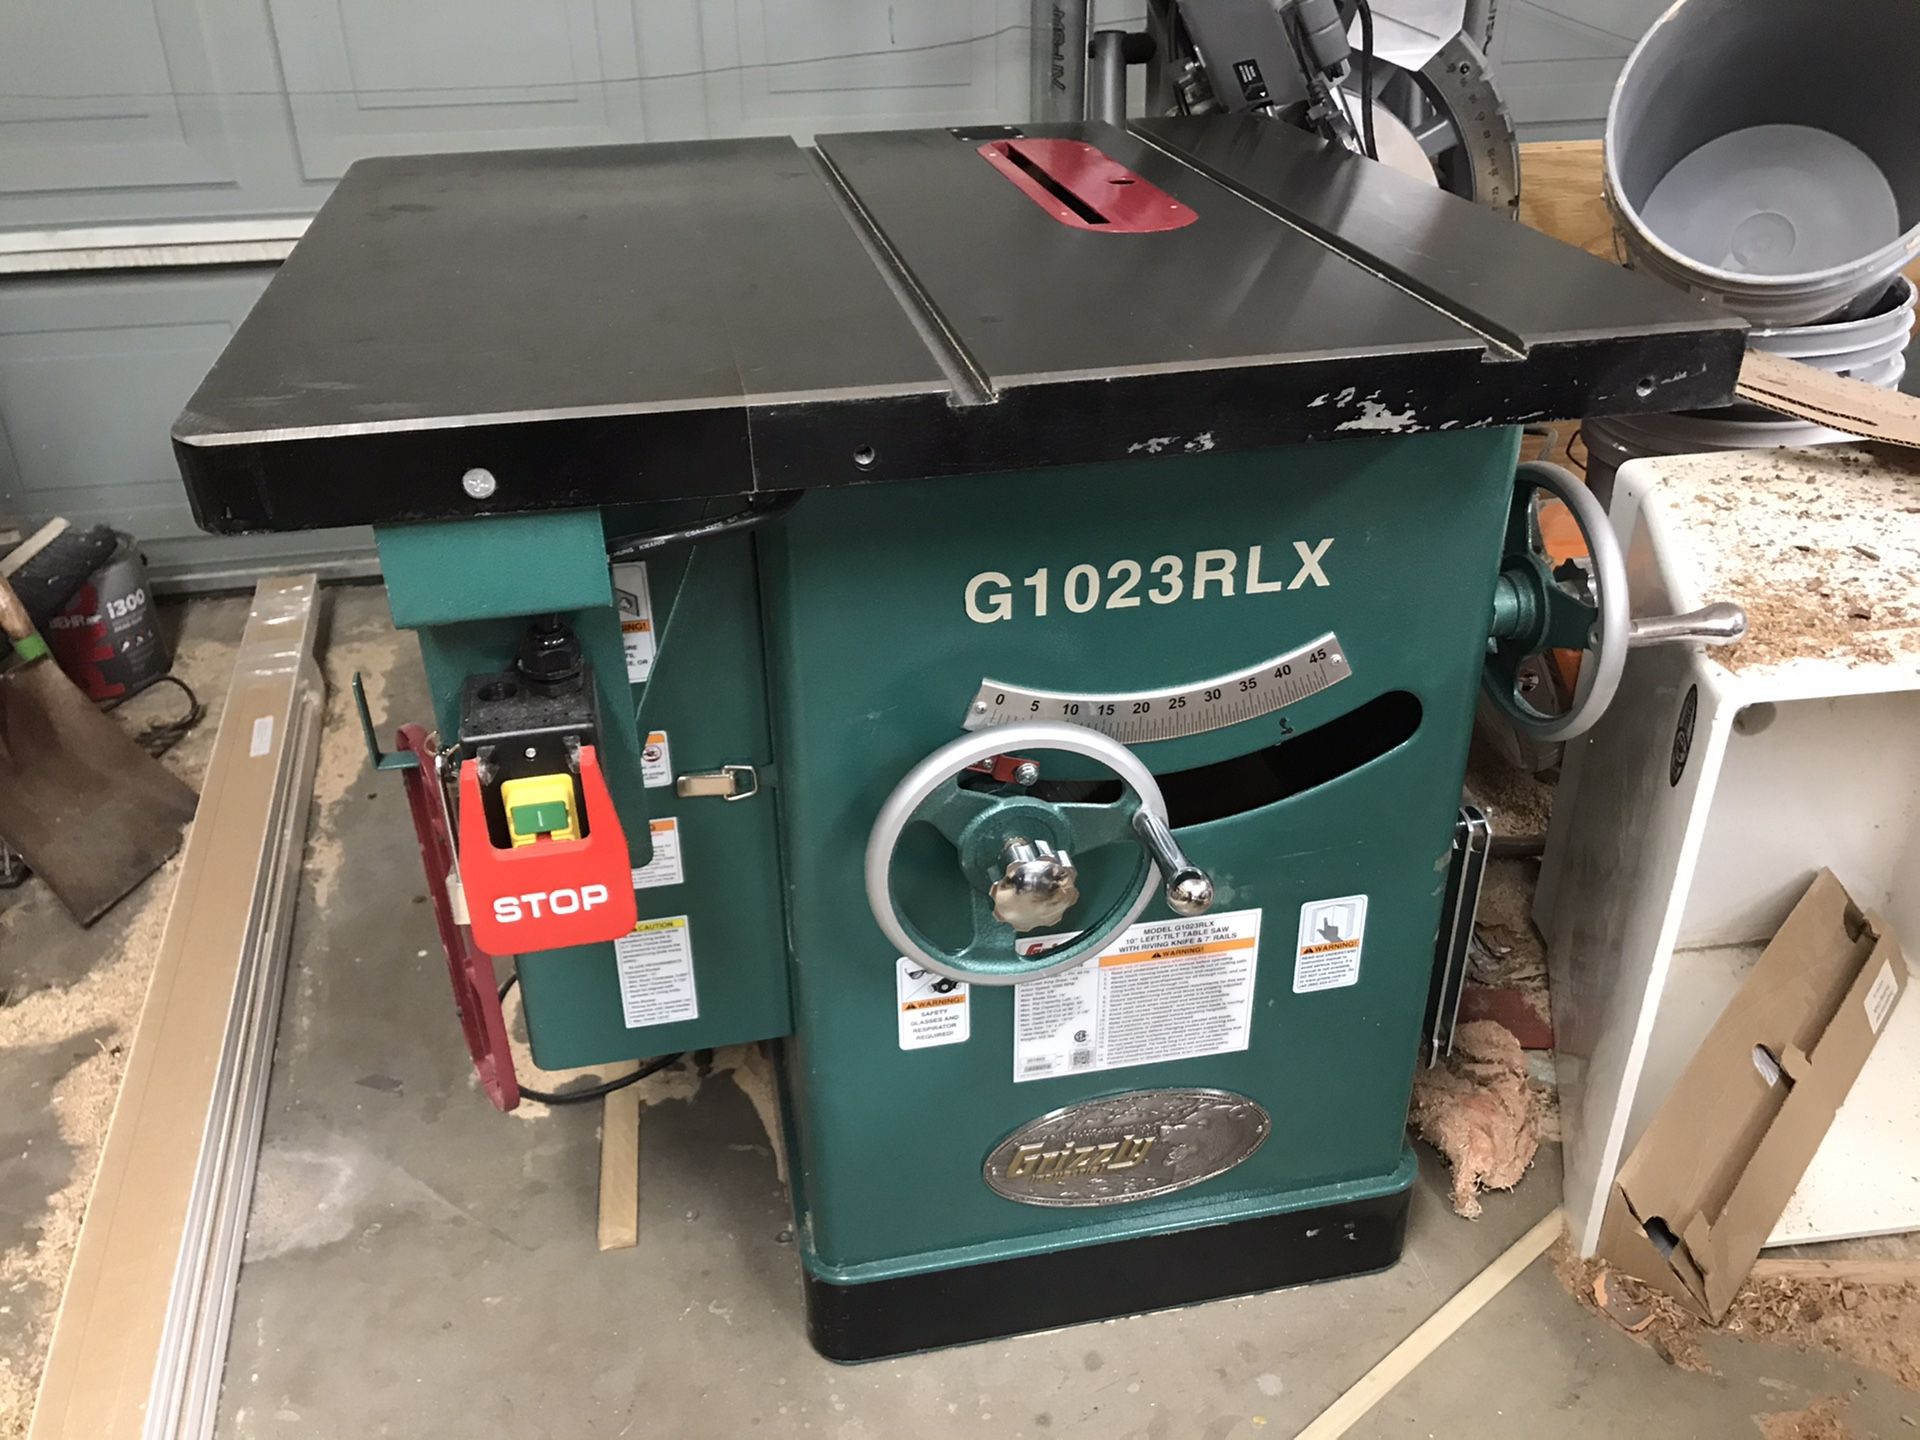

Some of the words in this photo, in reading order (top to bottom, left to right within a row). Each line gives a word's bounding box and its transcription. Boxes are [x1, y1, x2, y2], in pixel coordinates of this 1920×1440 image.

[965, 538, 1335, 624] G1023RLX
[995, 693, 1005, 706] 0
[1030, 700, 1040, 712] 5
[1062, 704, 1079, 716] 10
[1098, 704, 1115, 716] 15
[1132, 702, 1150, 715] 20
[1168, 697, 1186, 710] 25
[1204, 689, 1221, 702] 30
[1239, 678, 1257, 693] 35
[1274, 664, 1292, 680] 40
[1309, 648, 1327, 665] 45
[493, 884, 608, 923] STOP
[1140, 932, 1181, 943] LEFT-TILT
[1182, 929, 1209, 937] TABLE
[1211, 926, 1229, 934] SAW
[1144, 926, 1172, 935] MODEL
[1175, 920, 1215, 931] G1023RLX
[1119, 945, 1140, 953] WITH
[1141, 941, 1169, 950] RIVING
[1171, 938, 1195, 946] KNIFE
[1213, 932, 1238, 940] RAILS
[1315, 940, 1359, 952] WARNING!
[1162, 946, 1205, 957] WARNING!
[918, 997, 963, 1009] WARNING!
[921, 1009, 948, 1017] SAFETY
[910, 1017, 943, 1026] GLASSES
[913, 1022, 957, 1033] RESPIRATOR
[1007, 1134, 1156, 1179] Grizzly
